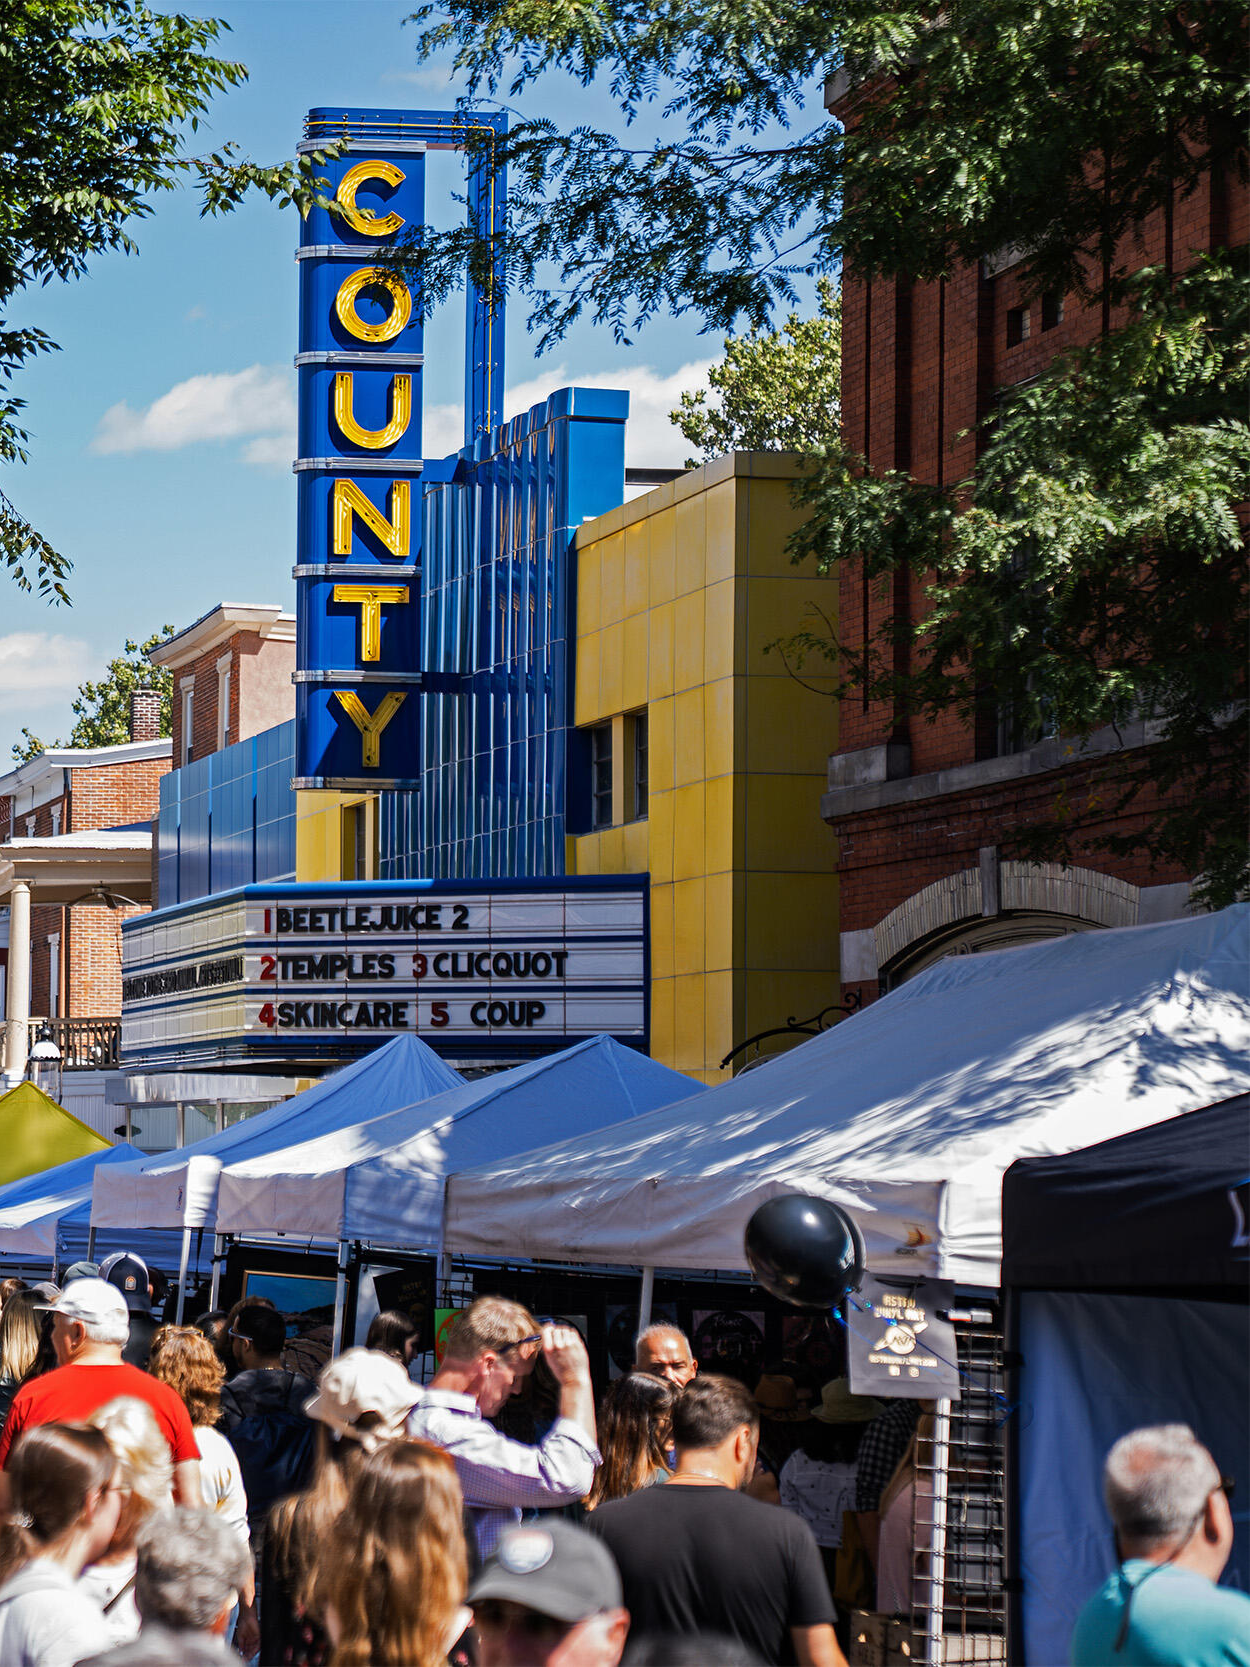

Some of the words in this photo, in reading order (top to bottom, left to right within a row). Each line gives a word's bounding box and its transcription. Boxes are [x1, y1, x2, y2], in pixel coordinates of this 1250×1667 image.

[334, 160, 412, 768] COUNTY
[264, 908, 271, 934] 1
[277, 905, 442, 933] BEETLEJUICE
[452, 905, 469, 930] 2
[260, 956, 276, 980] 2
[277, 953, 395, 980] TEMPLES
[412, 953, 428, 979] 3
[433, 951, 568, 978] CLICQUOT
[258, 1003, 276, 1028] 4
[277, 1002, 409, 1028] SKINCARE
[430, 1002, 450, 1027] 5
[470, 1001, 546, 1027] COUP
